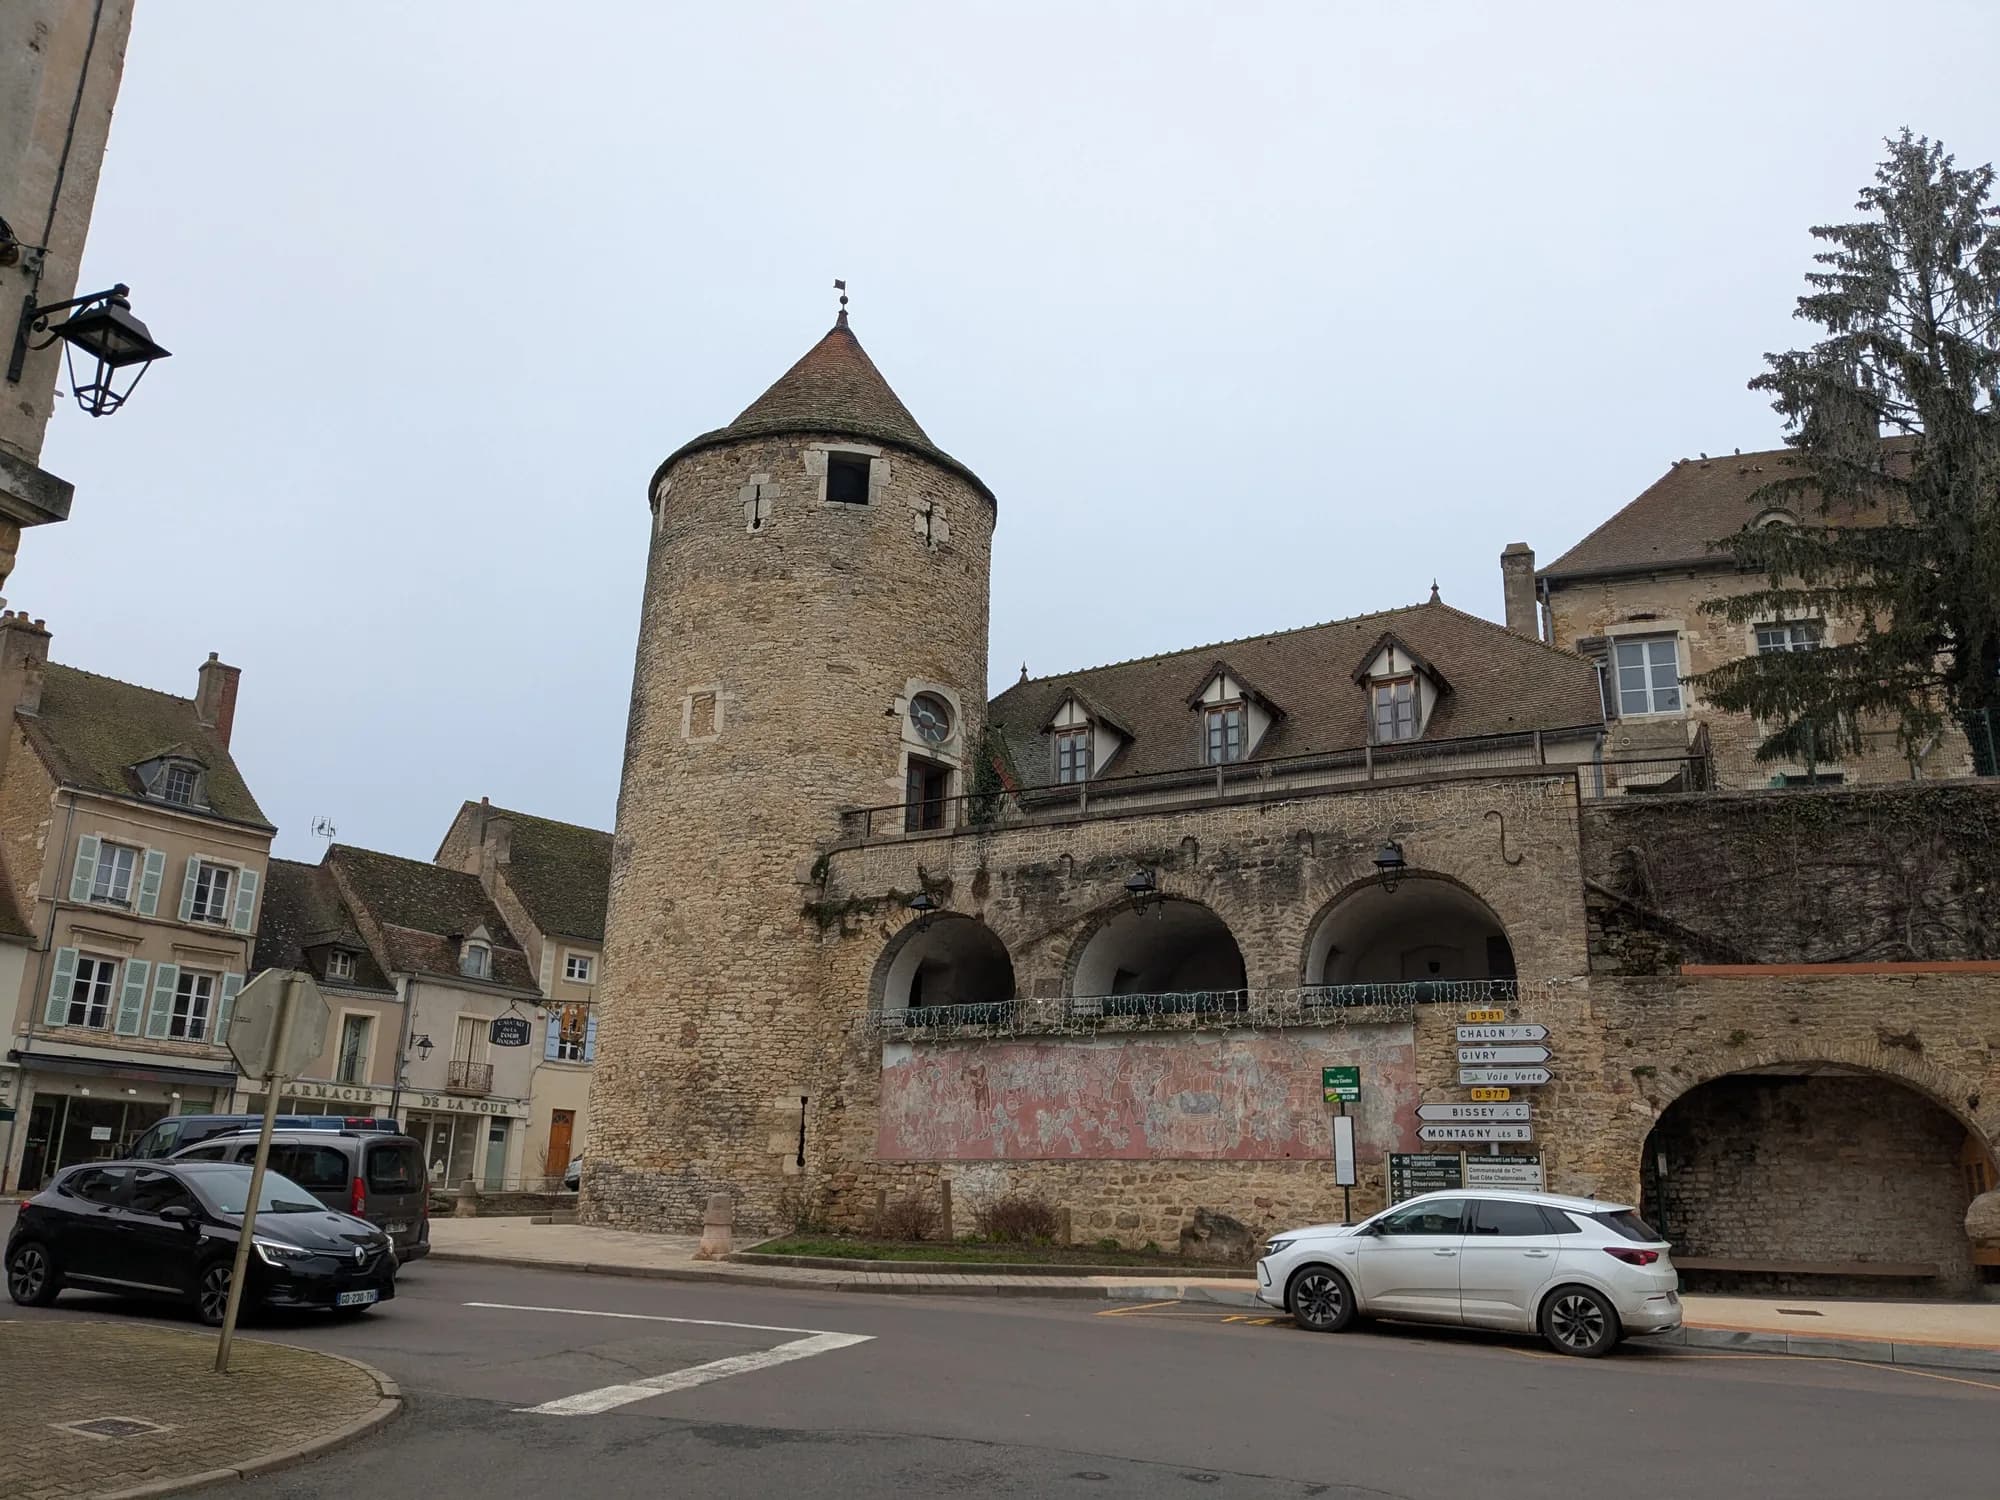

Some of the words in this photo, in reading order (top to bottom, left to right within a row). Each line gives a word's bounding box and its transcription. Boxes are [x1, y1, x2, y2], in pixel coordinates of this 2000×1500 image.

[1470, 1012, 1477, 1020] D
[1480, 1011, 1500, 1020] 981
[1460, 1028, 1505, 1038] CHALON
[1525, 1028, 1536, 1037] S.
[1462, 1050, 1497, 1060] GIVRY
[1486, 1072, 1508, 1080] Voie
[1514, 1072, 1542, 1080] Verte
[260, 1080, 373, 1101] PARMACIE
[447, 1100, 464, 1110] LA
[471, 1102, 508, 1114] TOUR
[1452, 1108, 1494, 1116] BISSEY
[1516, 1108, 1526, 1116] C.
[1428, 1129, 1491, 1138] MONTAGNY
[1517, 1129, 1528, 1138] B.
